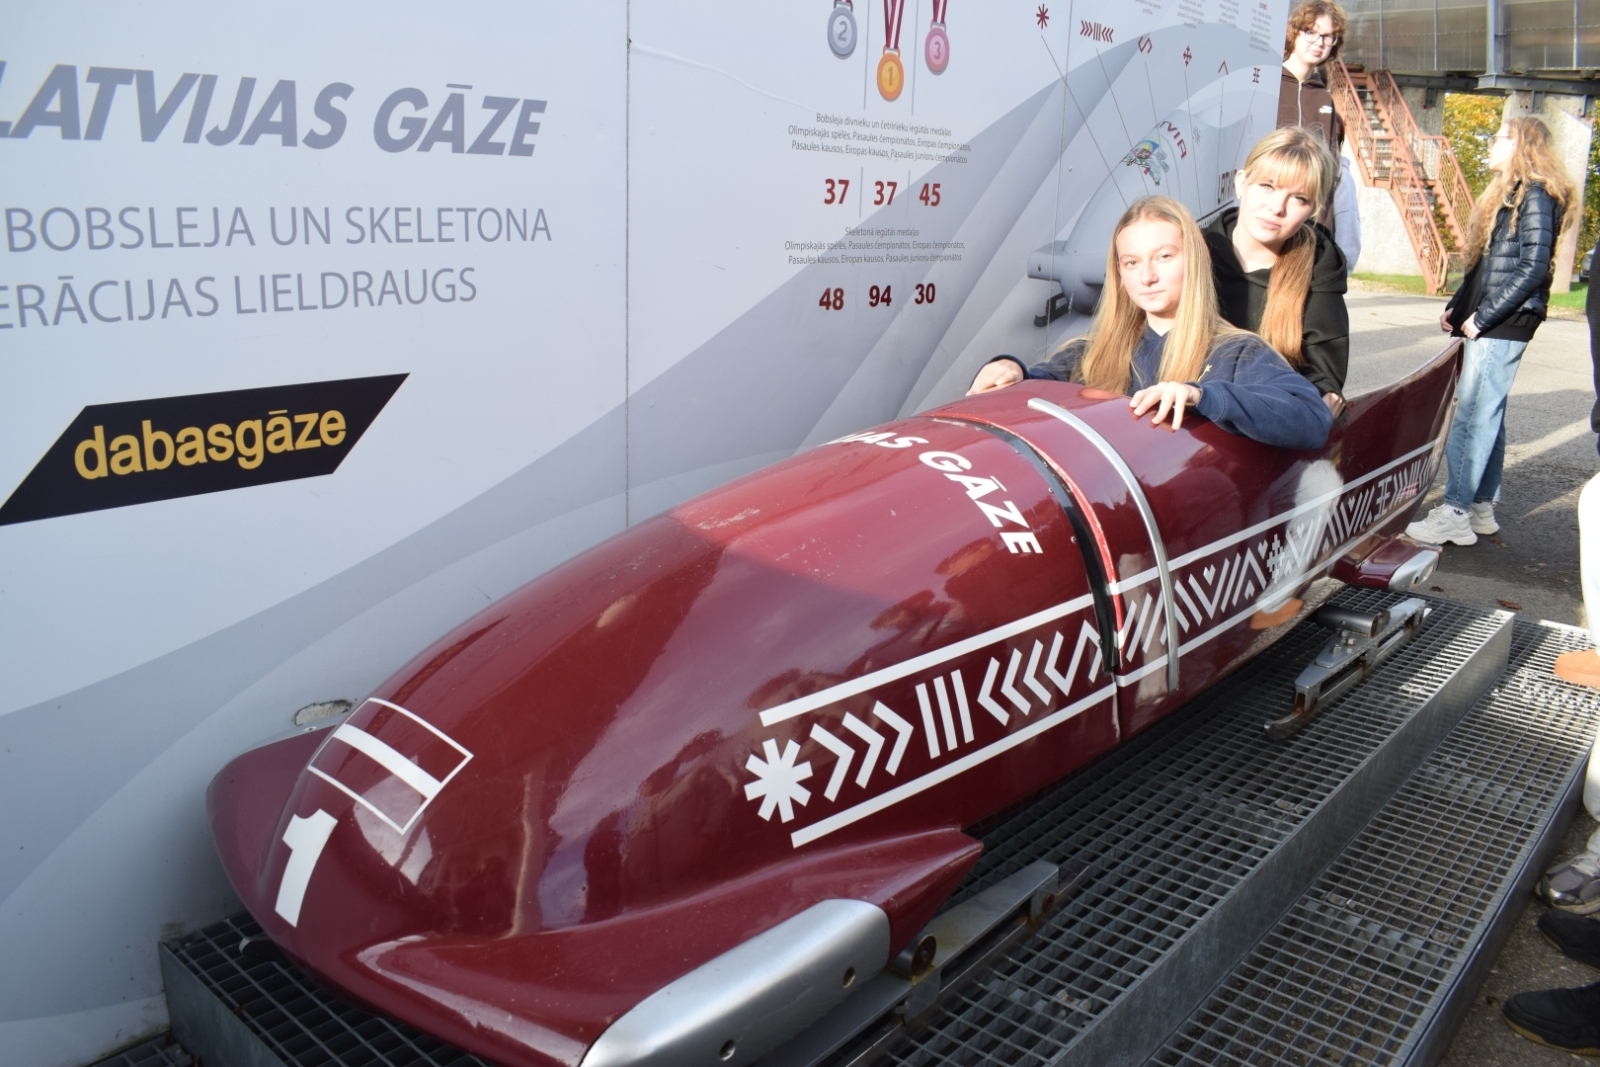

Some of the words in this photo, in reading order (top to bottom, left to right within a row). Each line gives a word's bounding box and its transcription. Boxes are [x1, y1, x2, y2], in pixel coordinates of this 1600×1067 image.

[837, 20, 848, 42] 2
[933, 41, 941, 60] 3
[887, 66, 894, 87] 1
[373, 83, 547, 157] GĀZE
[816, 112, 843, 127] Bobsleja
[844, 116, 870, 129] divnieku
[871, 120, 880, 129] un
[787, 124, 830, 140] Olimpiskajās
[852, 130, 878, 143] Pasaules
[917, 138, 937, 149] Eiropas
[792, 139, 820, 152] Pasaules
[821, 142, 845, 154] kausos,
[845, 144, 868, 157] Eiropas
[890, 148, 915, 161] Pasaules
[824, 178, 850, 205] 37
[873, 181, 898, 206] 37
[919, 183, 941, 207] 45
[4, 206, 256, 252] BOBSLEJA
[269, 207, 332, 246] UN
[345, 207, 552, 245] SKELETONA
[845, 226, 874, 236] Skeletonā
[784, 240, 826, 252] Olimpiskajās
[848, 240, 874, 250] Pasaules
[912, 240, 932, 250] Eiropas
[788, 254, 816, 265] Pasaules
[817, 254, 840, 264] kausos,
[841, 254, 863, 265] Eiropas
[863, 254, 885, 264] kausos,
[885, 253, 909, 263] Pasaules
[234, 267, 477, 314] LIELDRAUGS
[818, 288, 845, 311] 48
[868, 285, 892, 307] 94
[914, 282, 936, 305] 30
[74, 410, 347, 481] dabasgāze
[918, 451, 1044, 554] GĀZE
[274, 808, 339, 928] 1
